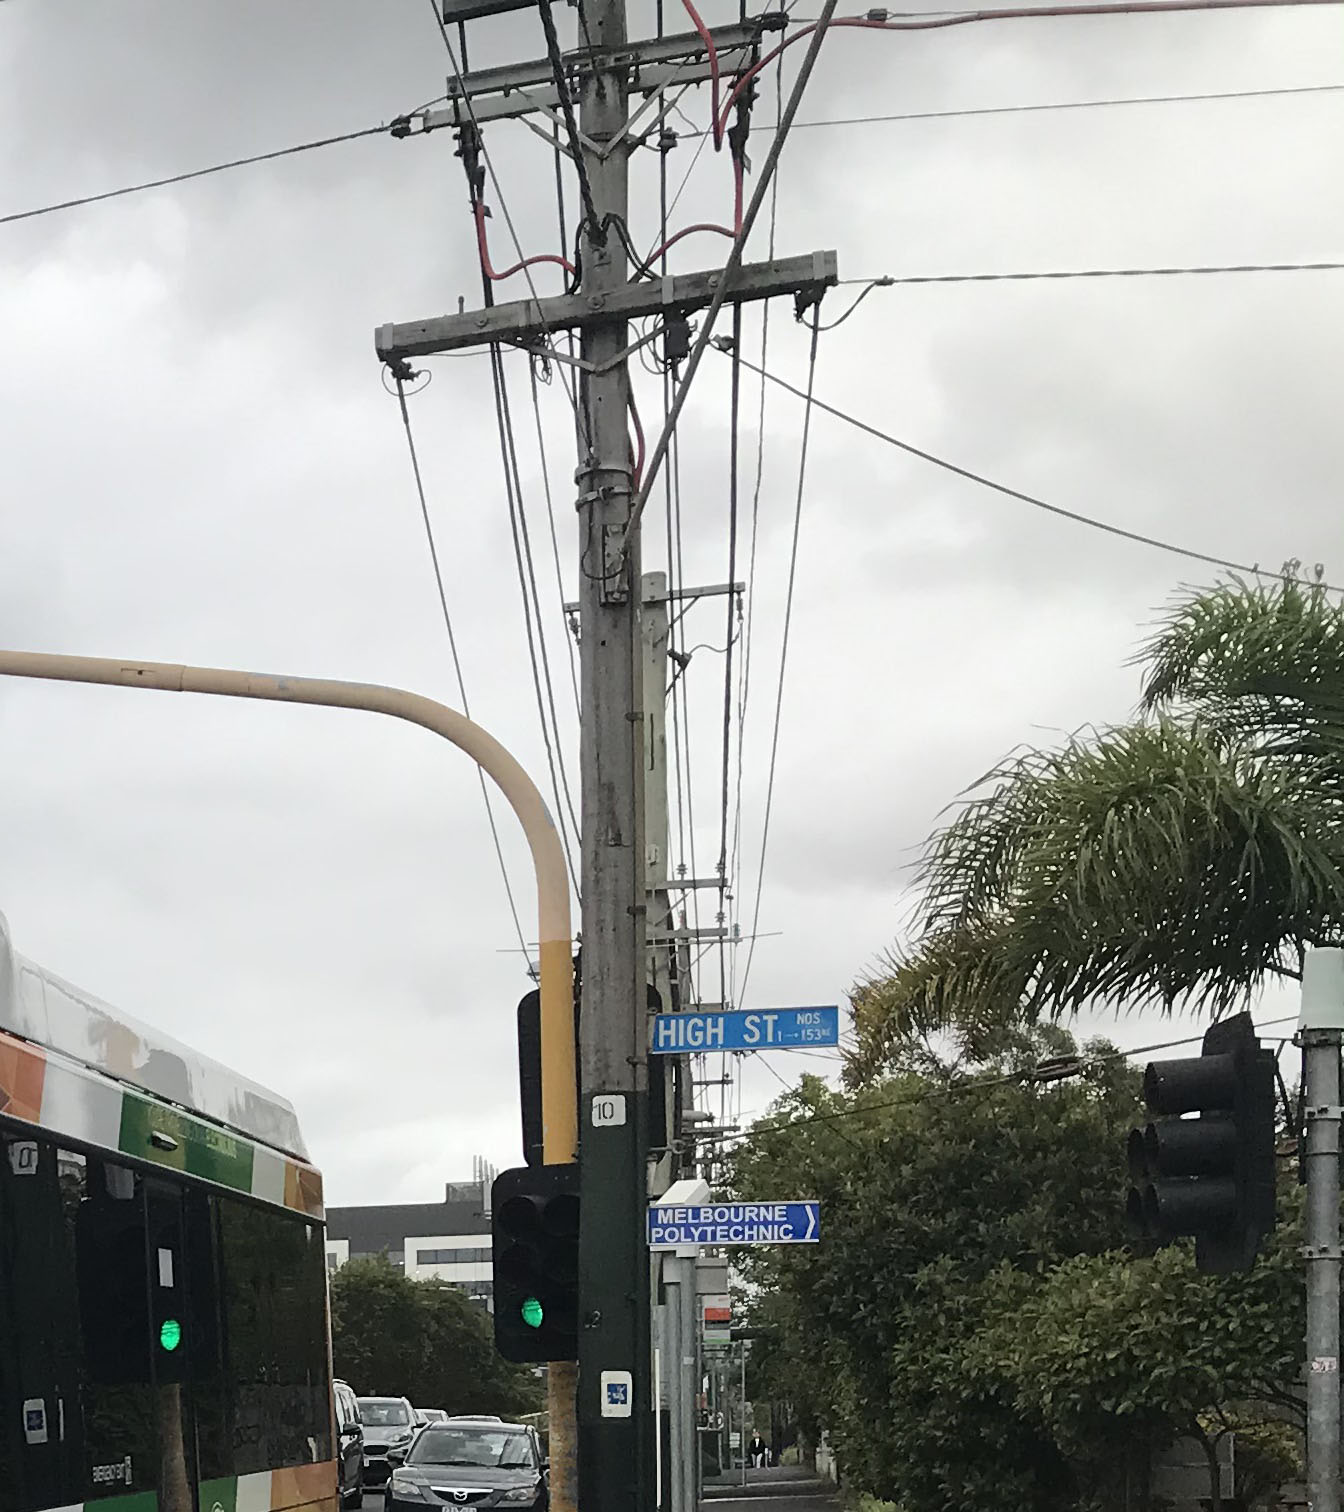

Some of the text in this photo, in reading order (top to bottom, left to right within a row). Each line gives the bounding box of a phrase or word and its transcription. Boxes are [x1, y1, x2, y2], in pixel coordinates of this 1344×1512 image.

[796, 1012, 821, 1025] NOS
[658, 1014, 779, 1048] HIGH ST
[593, 1102, 614, 1120] 10
[657, 1205, 787, 1225] MELBOURNE
[651, 1224, 794, 1244] POLYTECHNIC
